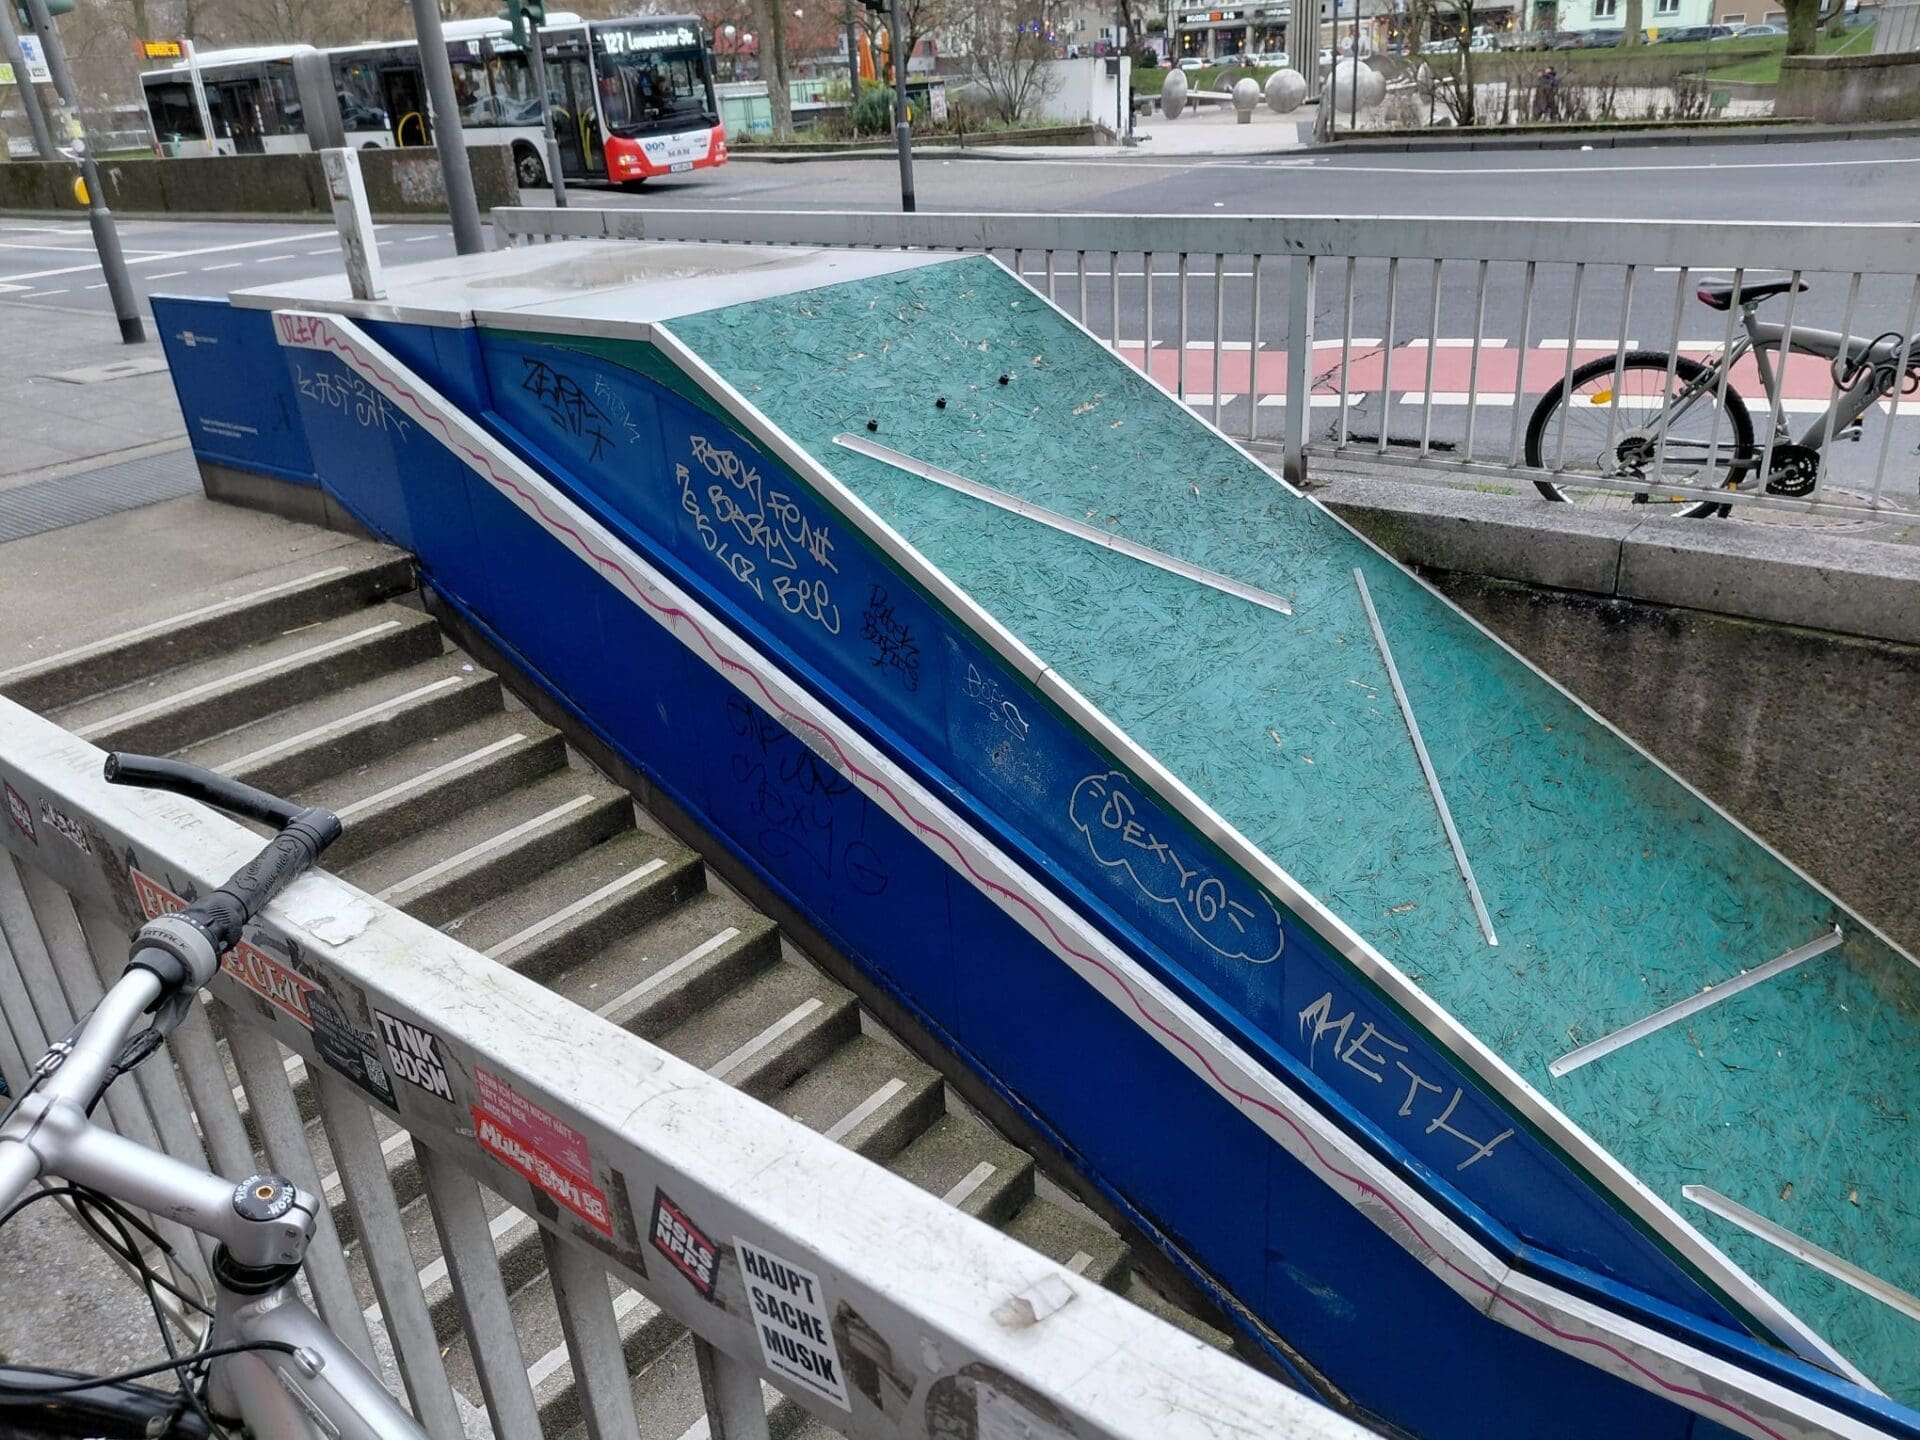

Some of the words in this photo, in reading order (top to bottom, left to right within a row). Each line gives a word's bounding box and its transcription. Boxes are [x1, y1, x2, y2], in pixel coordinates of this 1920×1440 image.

[602, 32, 624, 54] 127
[375, 1010, 442, 1068] TNK
[386, 1043, 454, 1101] BDSM
[1300, 991, 1514, 1171] METH
[656, 1221, 711, 1284] NPPS
[658, 1206, 713, 1270] BSLS
[741, 1246, 814, 1303] HAUPT
[750, 1286, 828, 1347] SACHE
[762, 1323, 838, 1386] MUSIK
